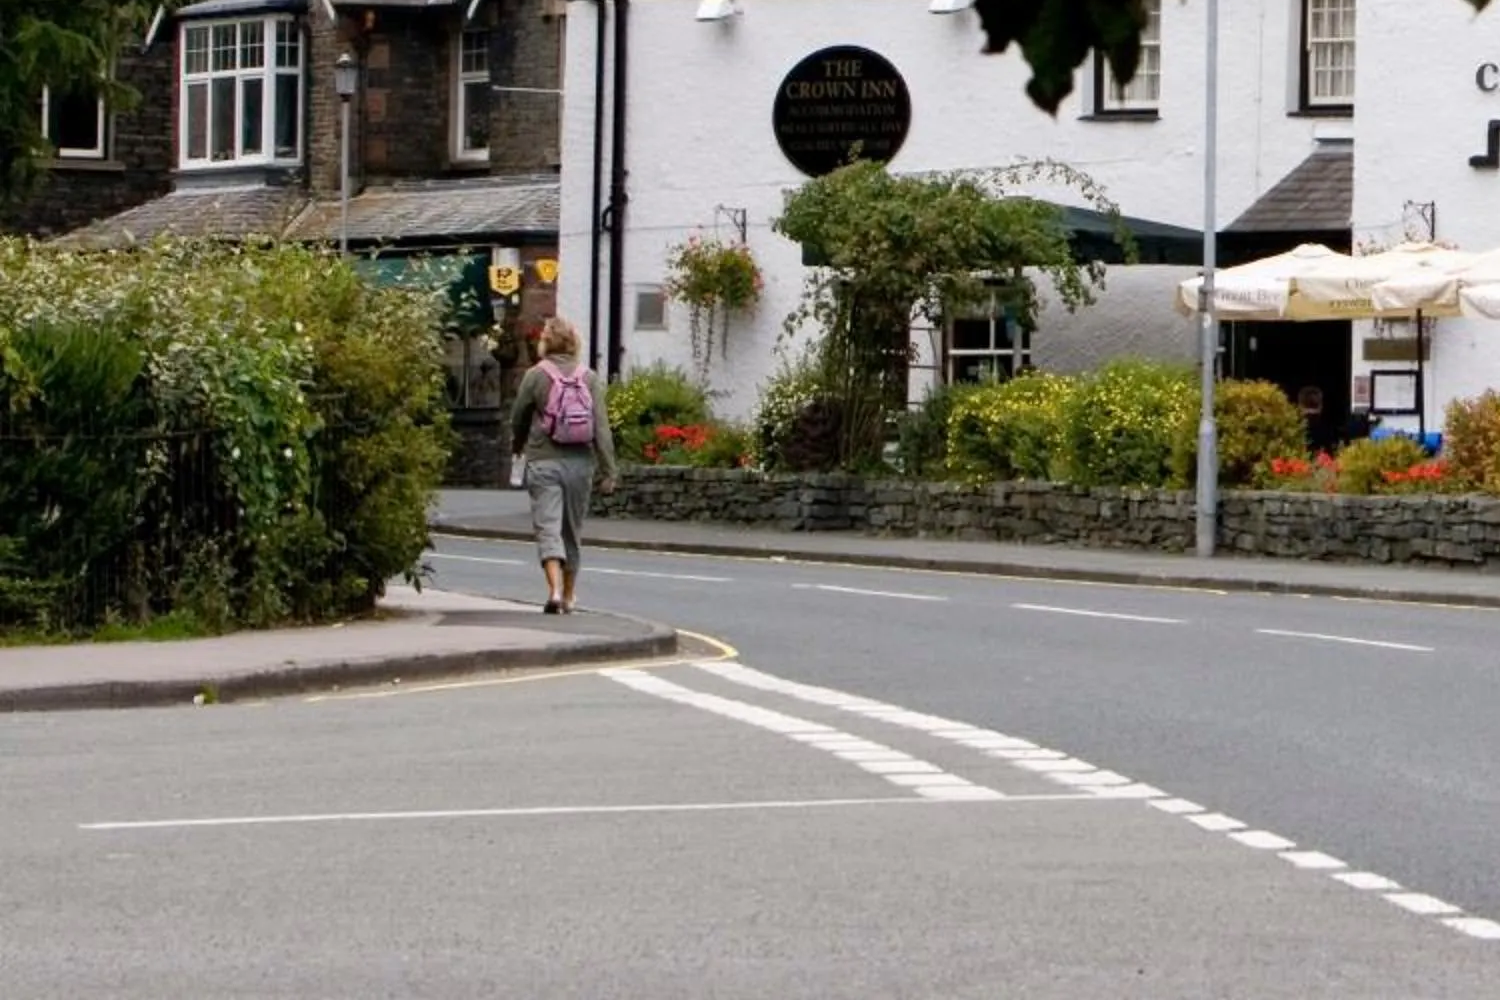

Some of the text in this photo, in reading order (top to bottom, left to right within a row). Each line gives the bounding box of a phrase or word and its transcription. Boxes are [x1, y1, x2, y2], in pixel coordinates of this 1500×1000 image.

[822, 60, 863, 77] THE
[786, 80, 897, 99] CROWN INN
